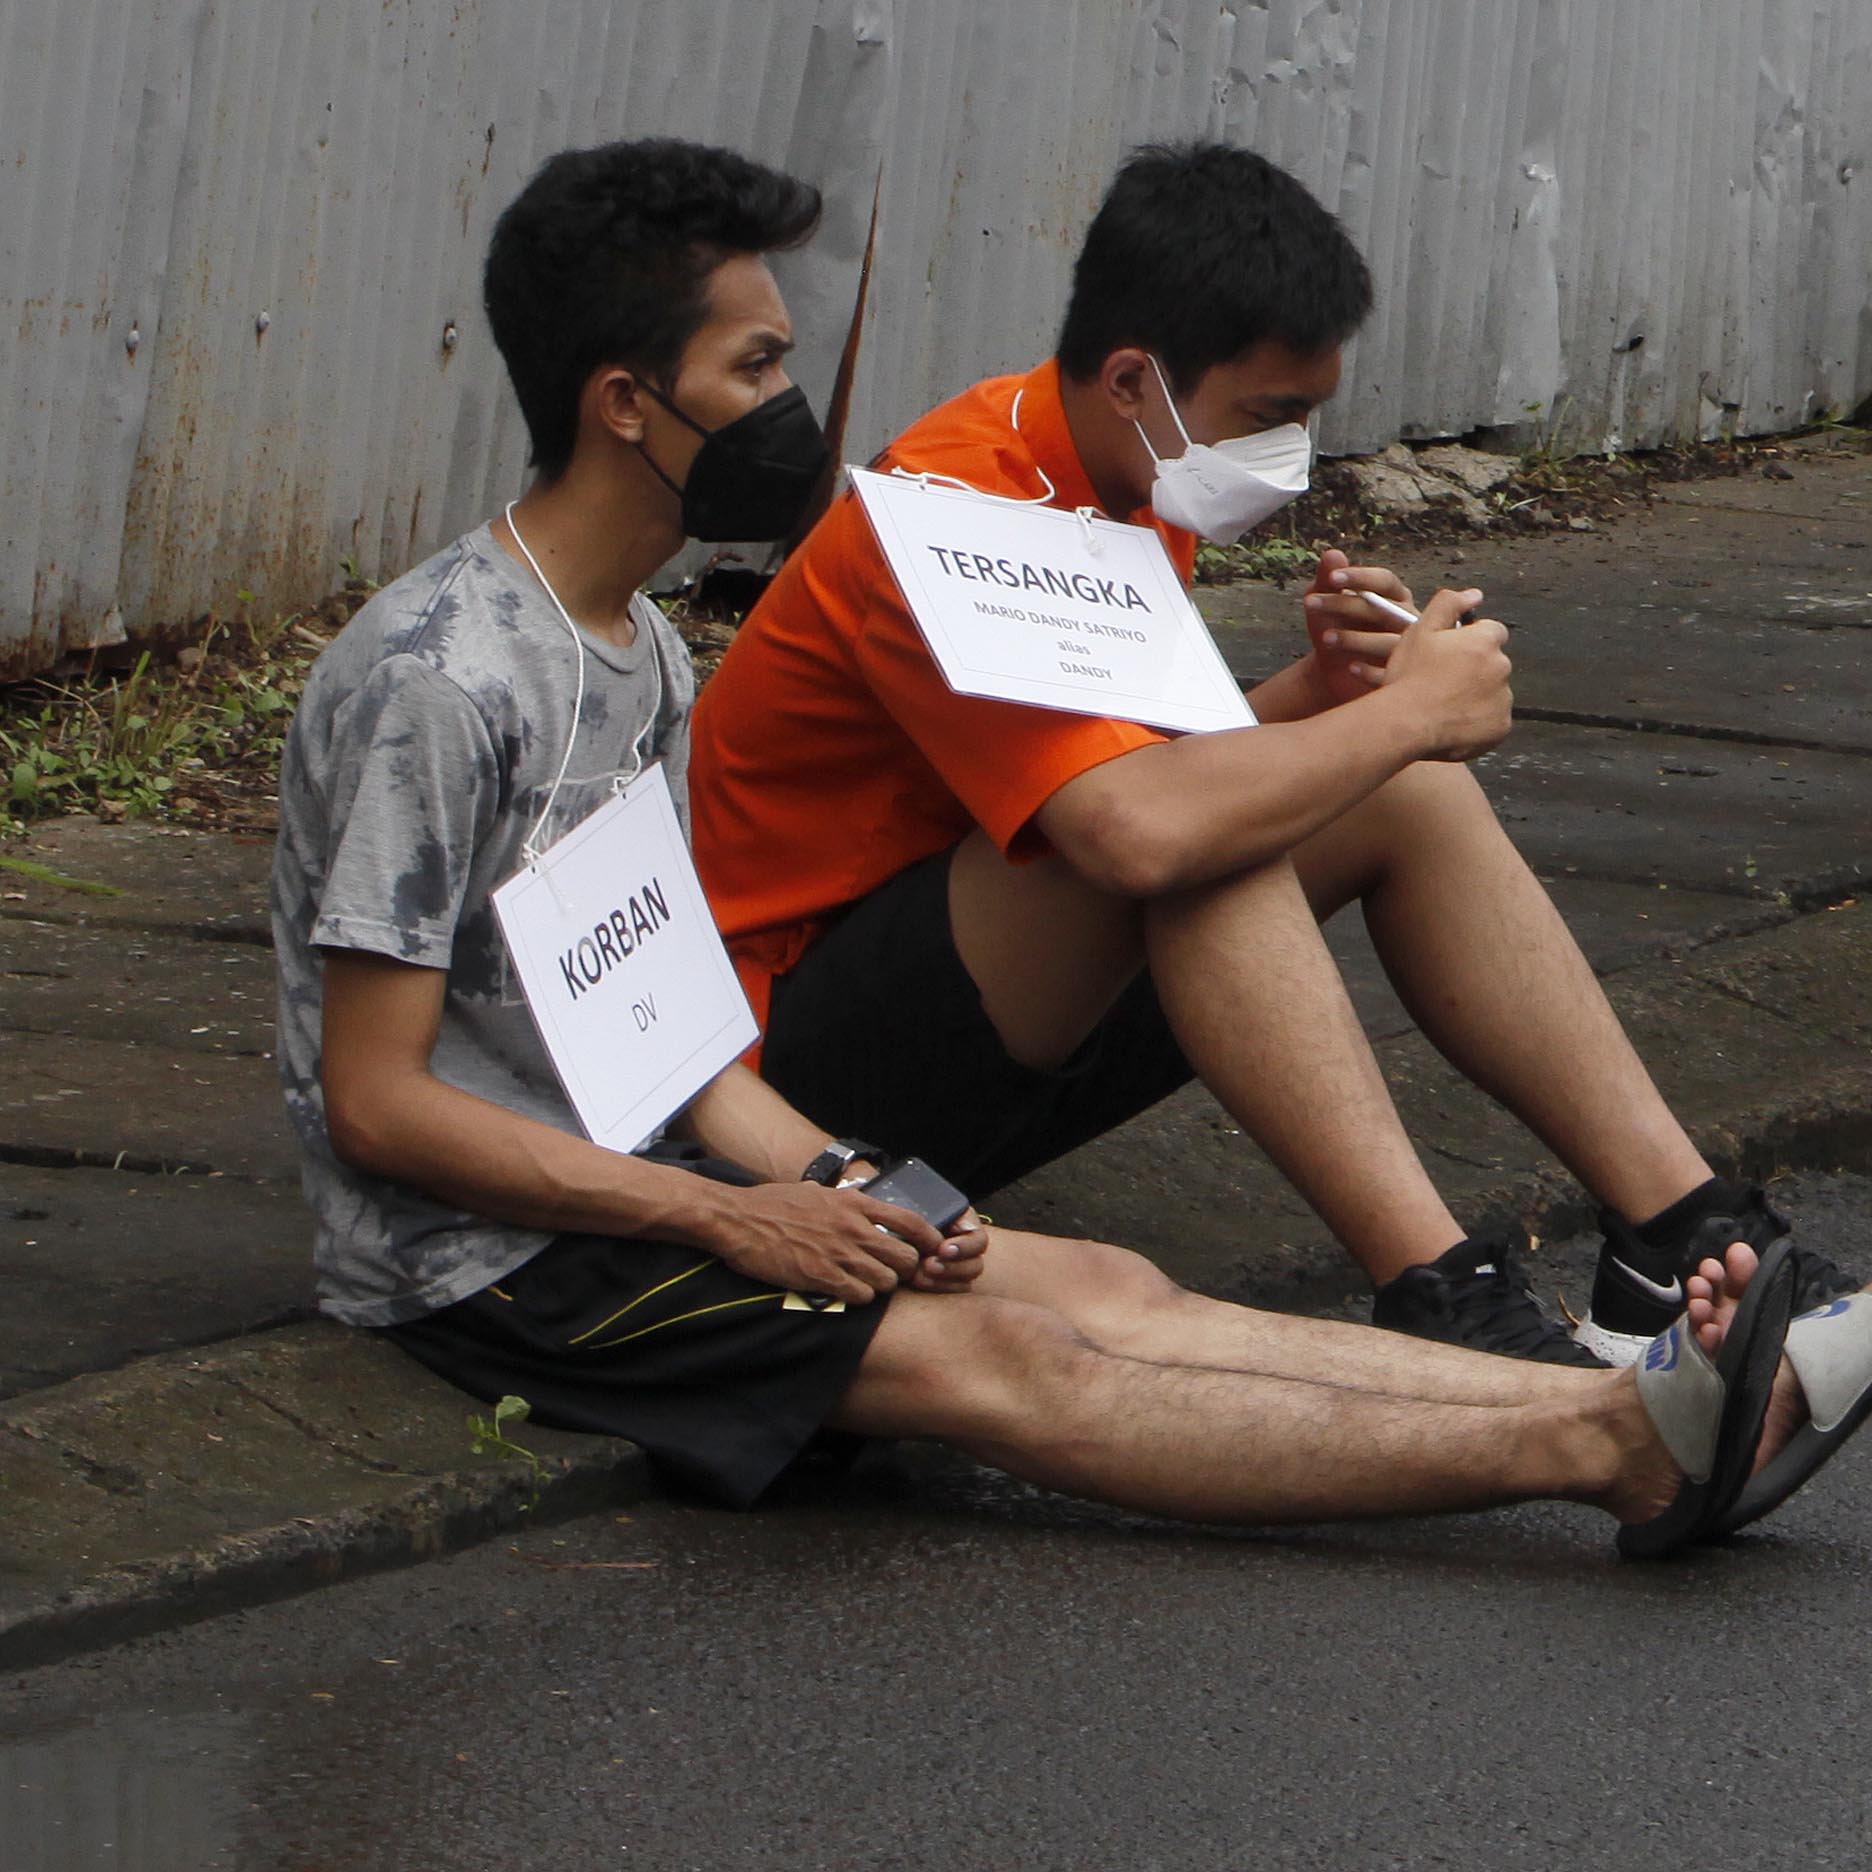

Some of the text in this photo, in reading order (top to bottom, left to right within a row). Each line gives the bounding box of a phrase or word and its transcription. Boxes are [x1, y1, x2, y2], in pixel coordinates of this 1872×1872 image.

[927, 545, 1152, 615] TERSANGKA
[973, 601, 1147, 644] MARIO DANDY SATRIYO
[1057, 640, 1091, 656] alias
[1059, 661, 1113, 680] DANDY
[558, 876, 671, 1001] KORBAN
[630, 991, 659, 1033] DV
